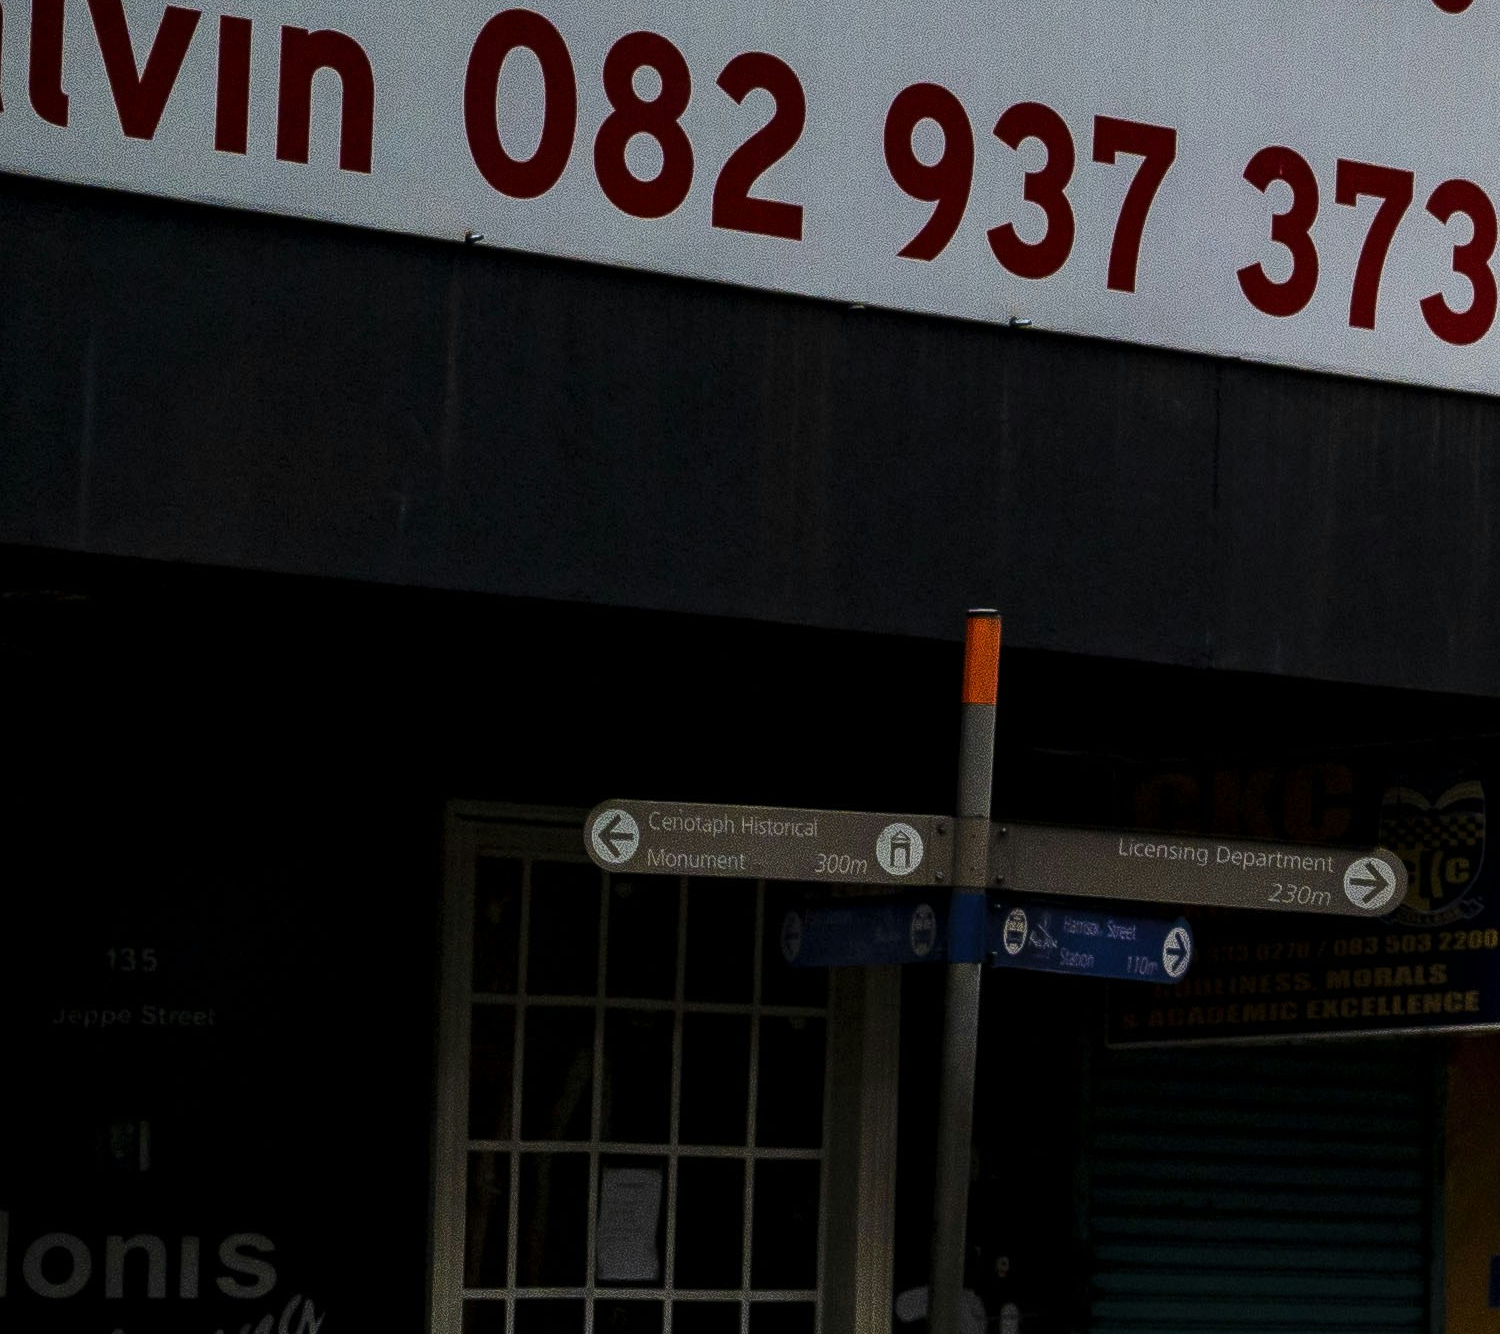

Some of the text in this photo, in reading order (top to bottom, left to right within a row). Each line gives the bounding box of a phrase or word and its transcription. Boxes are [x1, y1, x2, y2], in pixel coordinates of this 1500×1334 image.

[463, 7, 807, 242] 082
[882, 81, 1177, 293] 937
[1133, 761, 1356, 841] CKC
[648, 810, 819, 838] Cenotaph Historical
[646, 848, 868, 875] Monument 300m
[1118, 838, 1334, 874] Licensing Department
[1267, 882, 1332, 907] 230m
[1106, 918, 1137, 941] Street
[1332, 933, 1379, 958] 083
[1385, 931, 1433, 956] 503
[1437, 927, 1499, 952] 2200
[106, 947, 159, 973] 135
[1324, 961, 1449, 991] MORALS
[51, 1003, 217, 1030] Jeppe Street
[1147, 1001, 1300, 1030] ACADEMIC
[1305, 989, 1481, 1021] EXCELLENCE
[0, 1210, 279, 1301] onis
